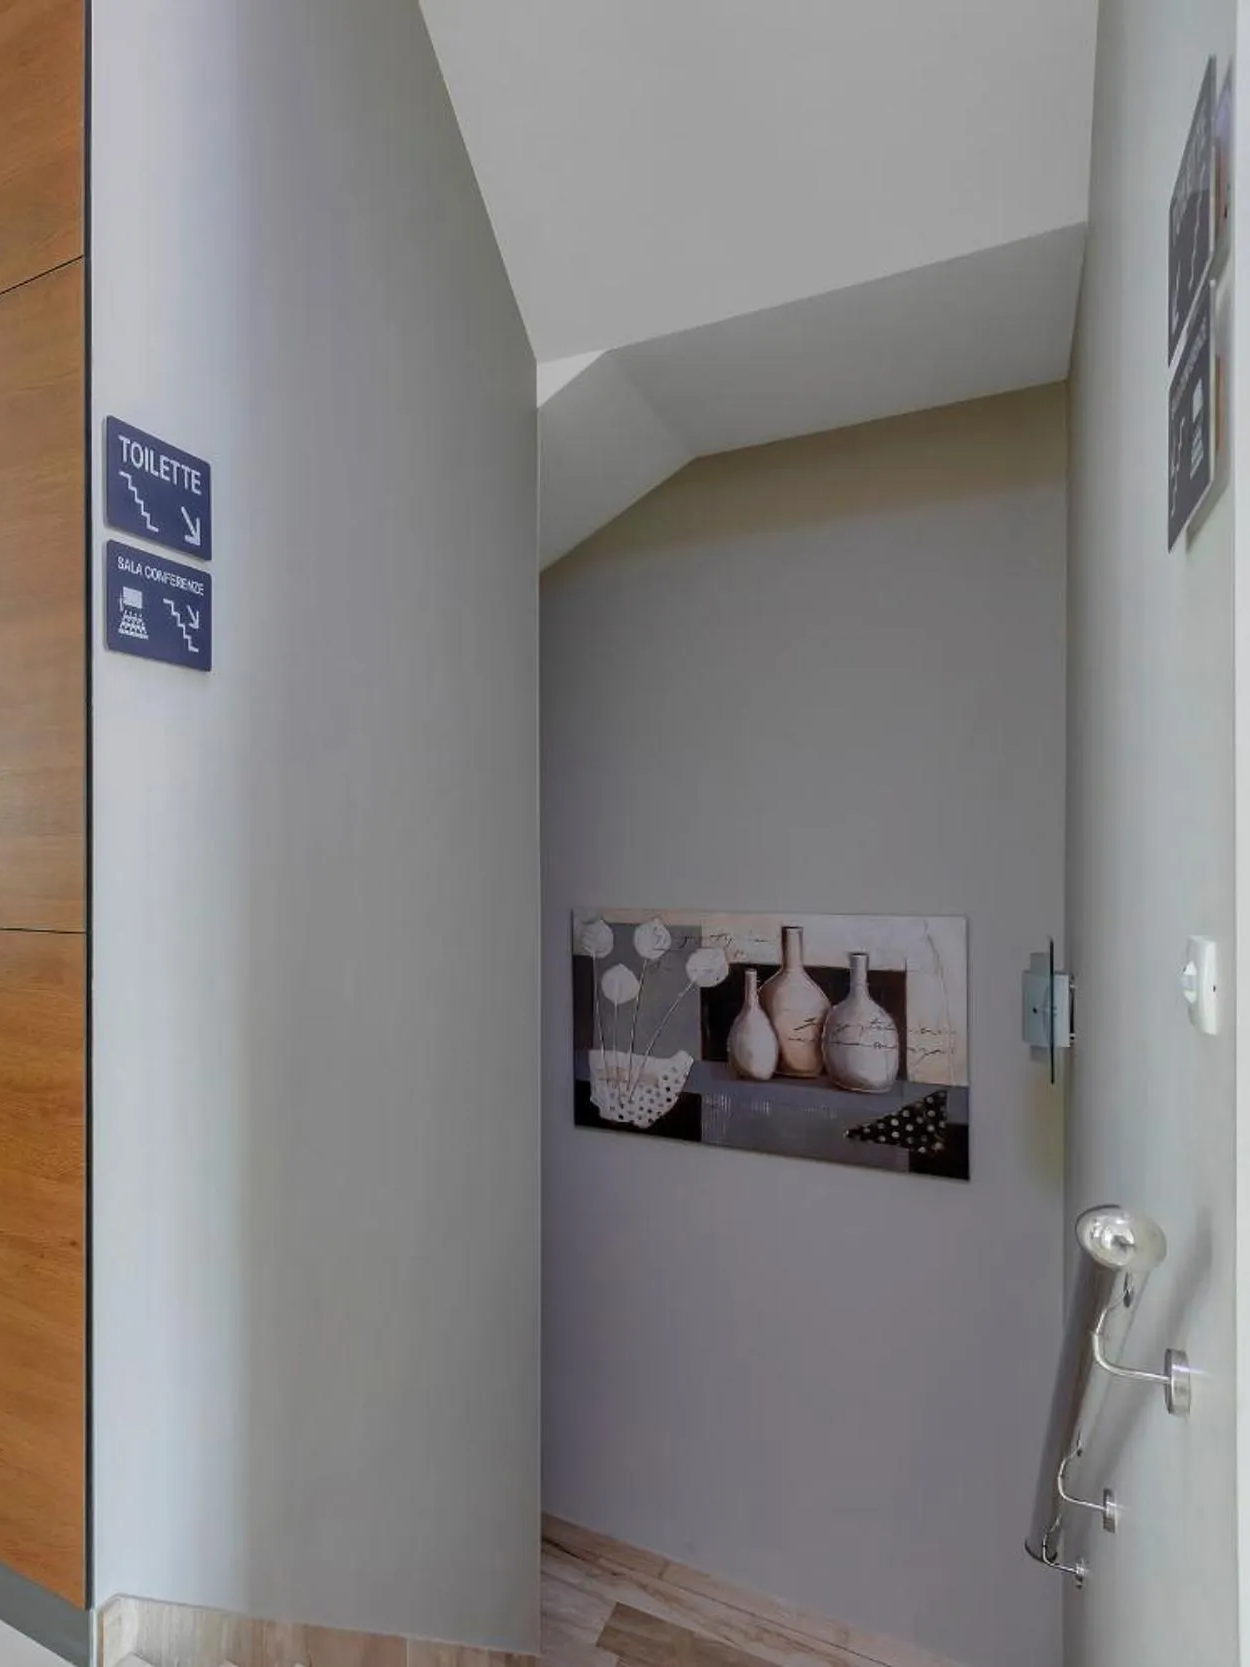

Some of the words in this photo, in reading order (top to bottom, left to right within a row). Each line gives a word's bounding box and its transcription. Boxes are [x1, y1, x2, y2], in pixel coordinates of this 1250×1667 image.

[118, 435, 202, 495] TOILETTE
[117, 556, 143, 576] SALA
[144, 567, 204, 596] CONFERENZE
